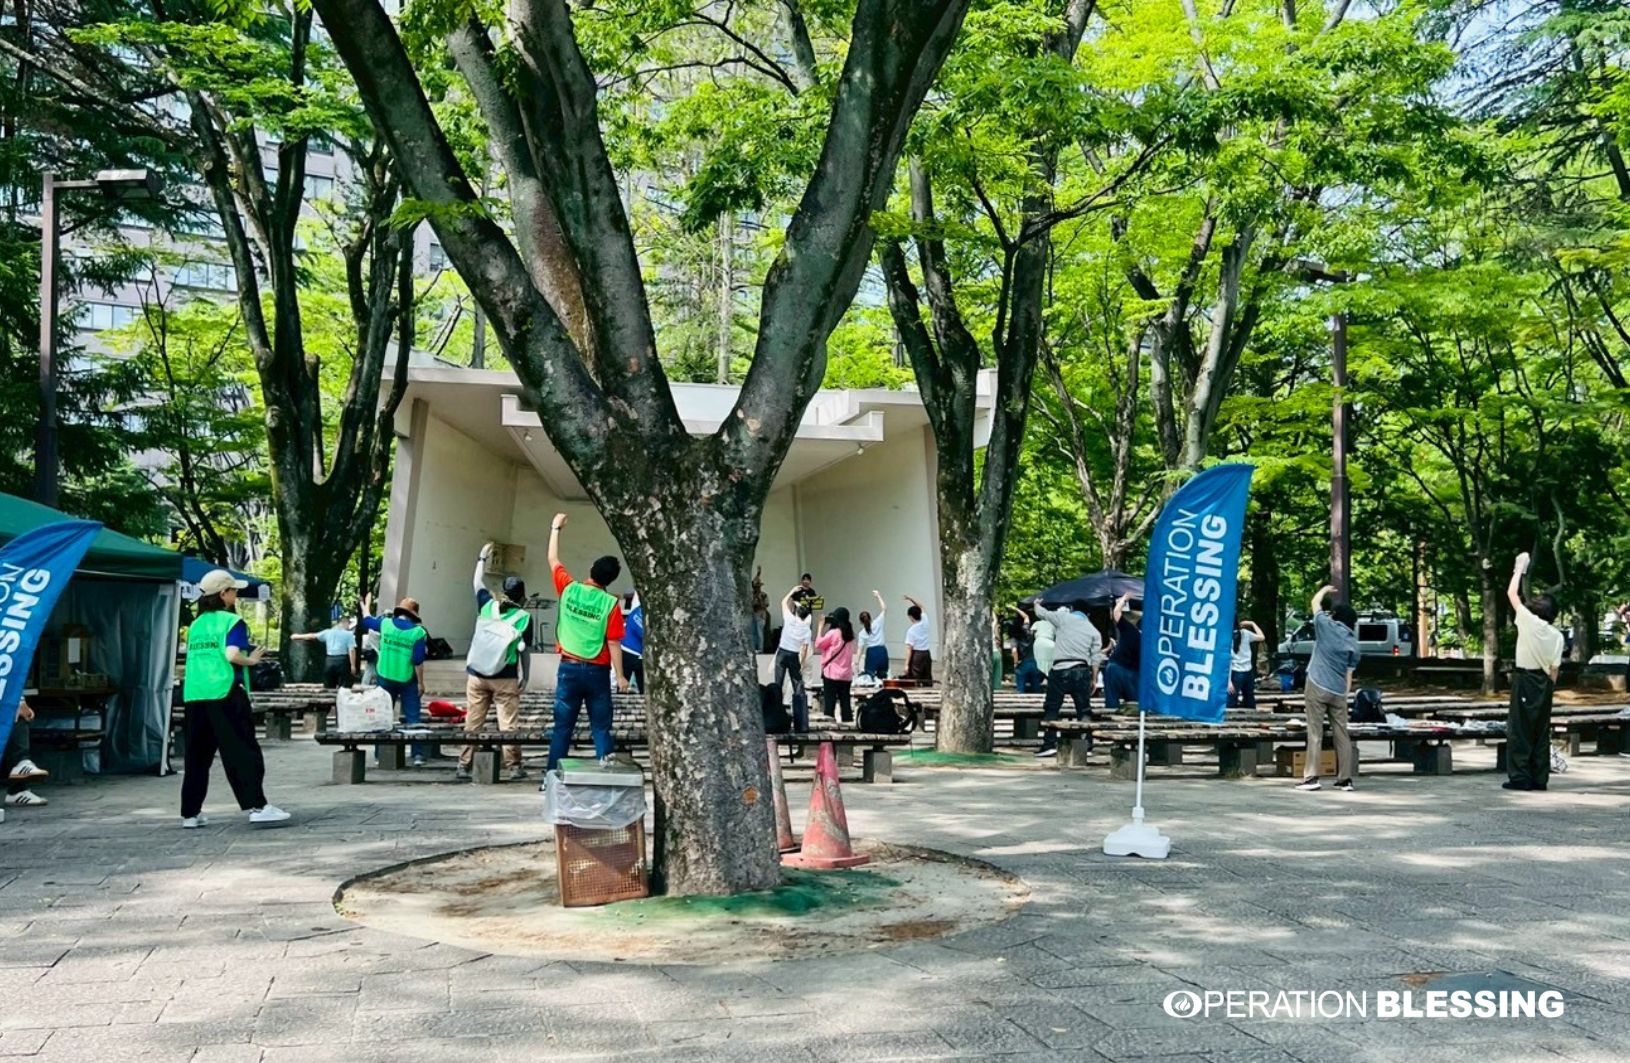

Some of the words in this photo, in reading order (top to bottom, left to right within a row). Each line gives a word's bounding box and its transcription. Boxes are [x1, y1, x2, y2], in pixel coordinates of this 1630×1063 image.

[0, 568, 51, 700] SSING
[1156, 508, 1199, 697] OPERATION
[1181, 513, 1227, 702] BLESSING
